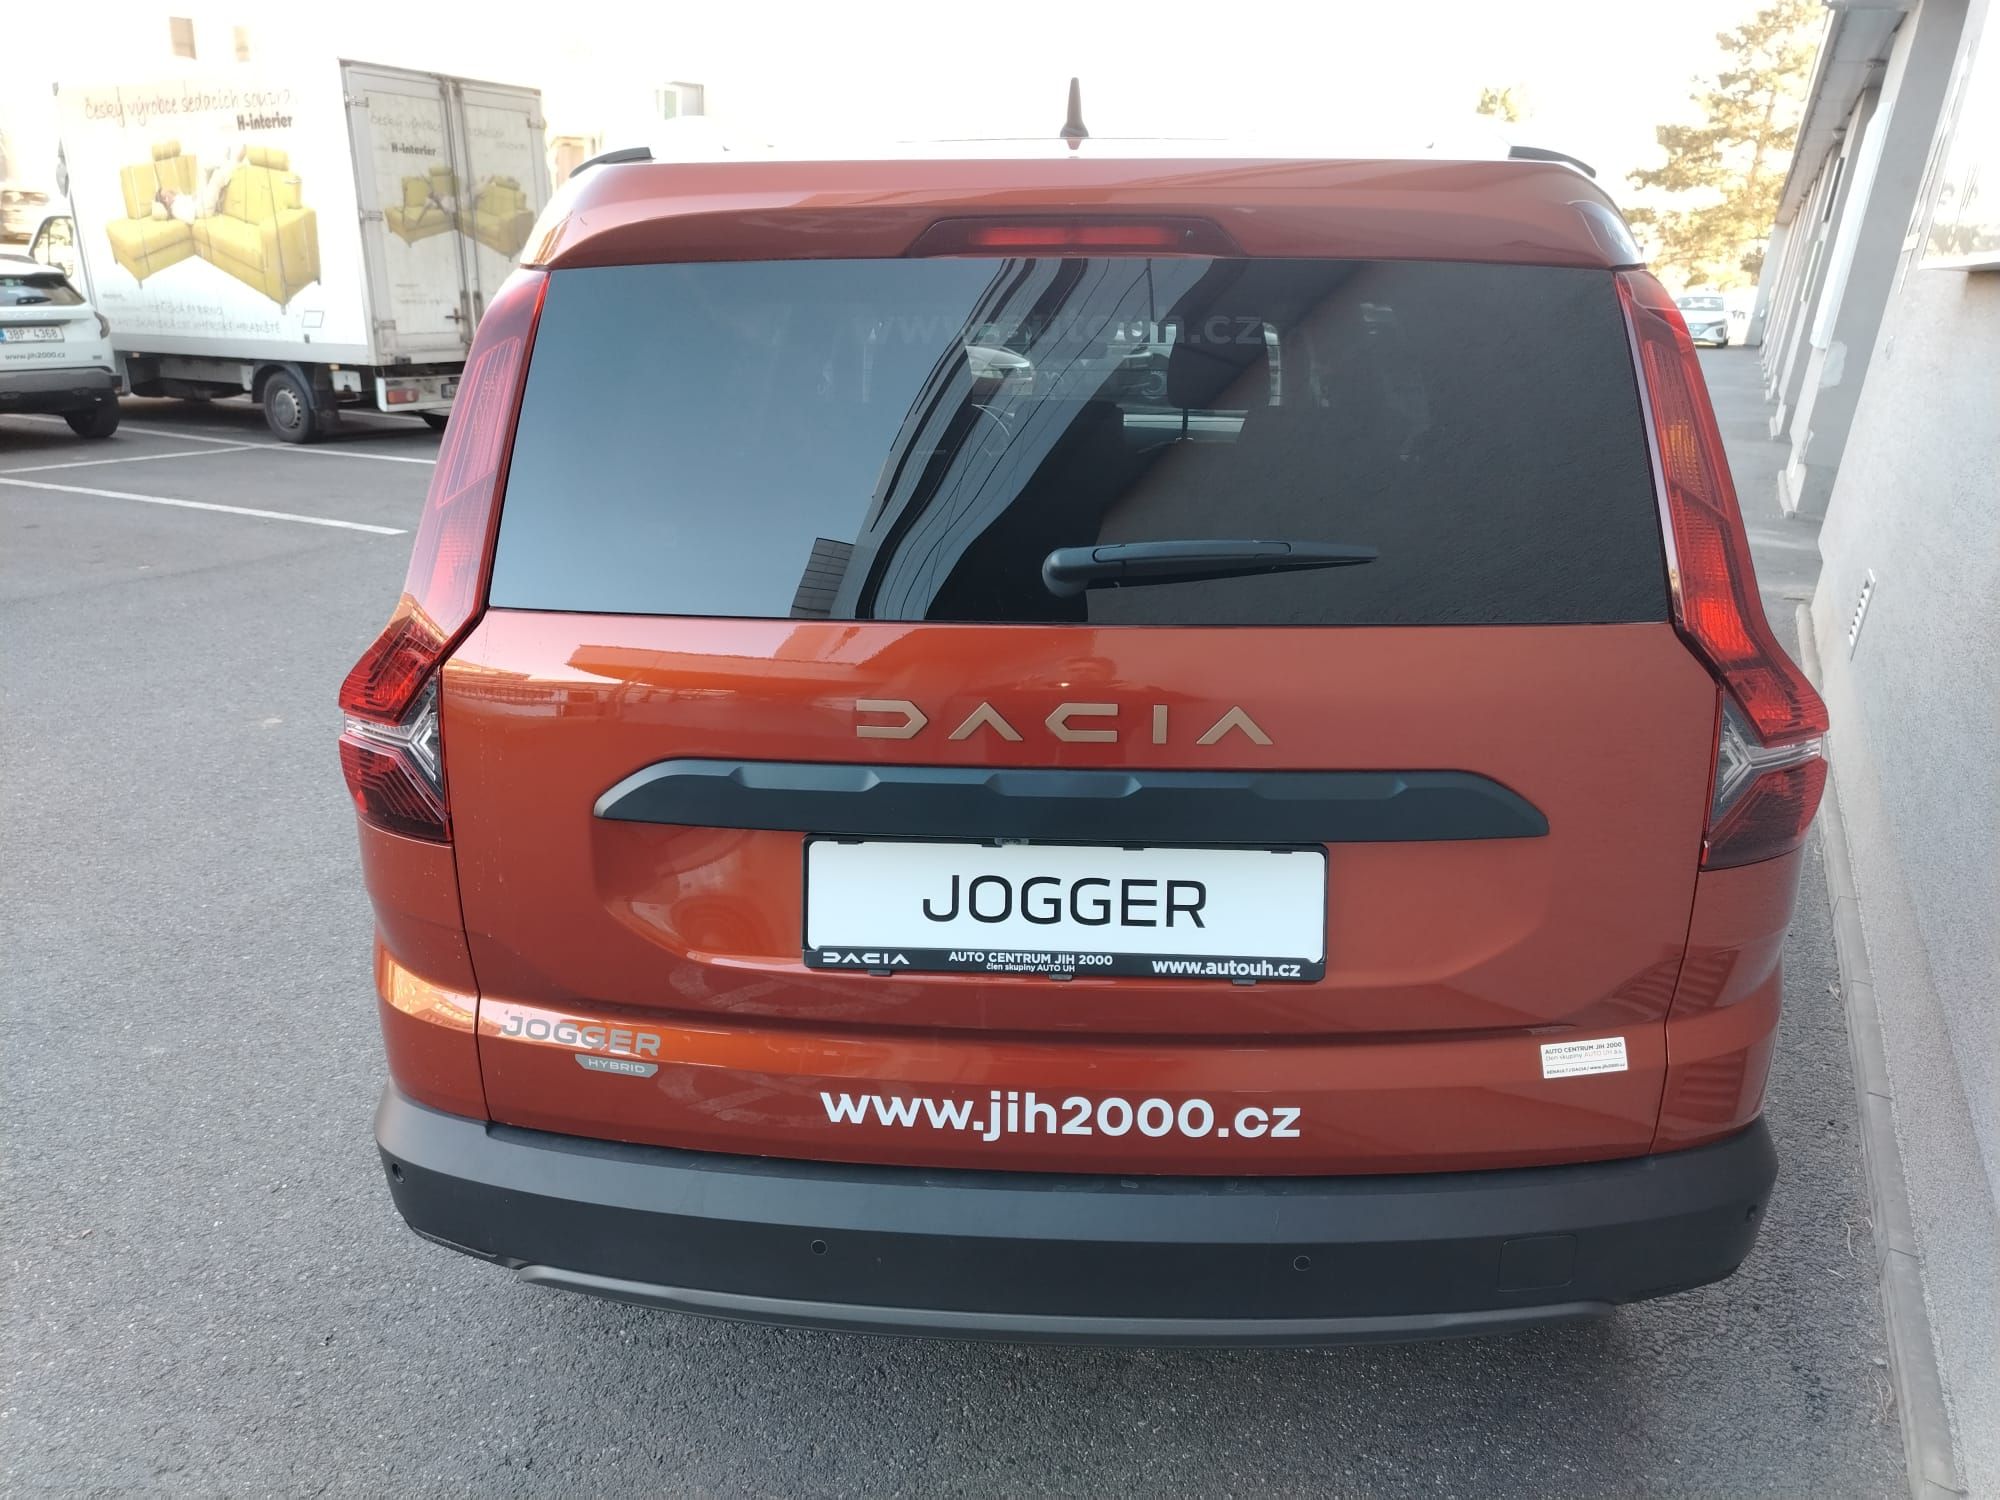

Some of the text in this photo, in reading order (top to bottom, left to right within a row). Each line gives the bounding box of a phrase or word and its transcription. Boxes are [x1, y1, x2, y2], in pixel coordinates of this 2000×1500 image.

[236, 111, 293, 131] H-interier
[391, 142, 437, 157] H-interier
[856, 699, 1273, 746] DACIA
[922, 874, 1207, 929] JOGGER
[823, 952, 910, 965] DACIA
[948, 951, 1113, 966] AUTO CENTRUM JIH 2000
[1004, 963, 1036, 972] skupiny
[1036, 964, 1061, 972] AUTO
[1062, 964, 1076, 972] UH
[1152, 960, 1301, 977] www.autouh.cz
[501, 1015, 660, 1056] JOGGER
[1545, 1047, 1562, 1055] AUTO
[1564, 1045, 1594, 1053] CENTRUM
[588, 1058, 645, 1073] HYBRID
[820, 1090, 1301, 1142] www.jih2000.cz
